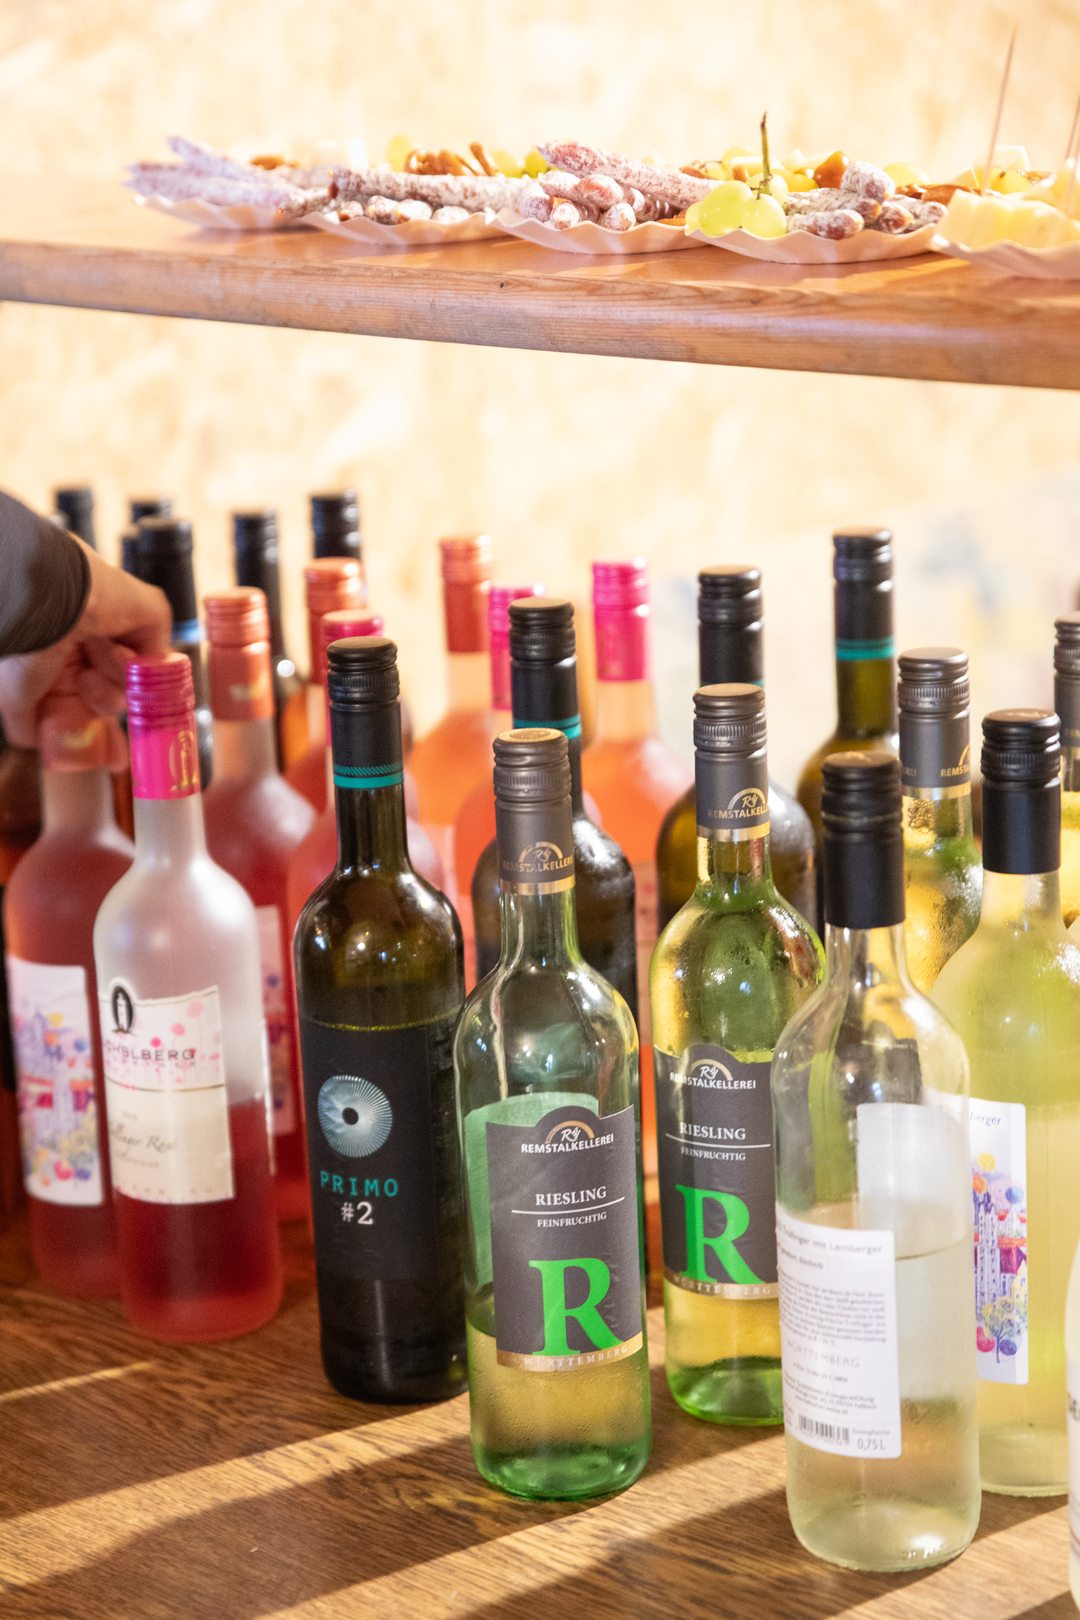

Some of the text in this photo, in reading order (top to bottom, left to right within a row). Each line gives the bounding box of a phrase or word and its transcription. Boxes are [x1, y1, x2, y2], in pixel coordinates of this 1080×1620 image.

[707, 802, 769, 819] REMSTALKELLE
[502, 854, 574, 873] REMSTALKELLERE
[669, 1071, 757, 1090] REMSTALKELLEREI
[969, 1111, 1002, 1127] berger
[679, 1121, 746, 1141] RIESLING
[520, 1133, 615, 1155] REMSTALKELLEREI
[680, 1146, 747, 1162] FEINFRUCHTIG
[319, 1169, 399, 1198] PRIMO
[535, 1185, 607, 1206] RIESLING
[340, 1200, 375, 1226] #2
[536, 1211, 608, 1229] FEINFRUCHTIG
[675, 1184, 767, 1285] R
[528, 1256, 625, 1356] R
[857, 1438, 879, 1452] 0,75
